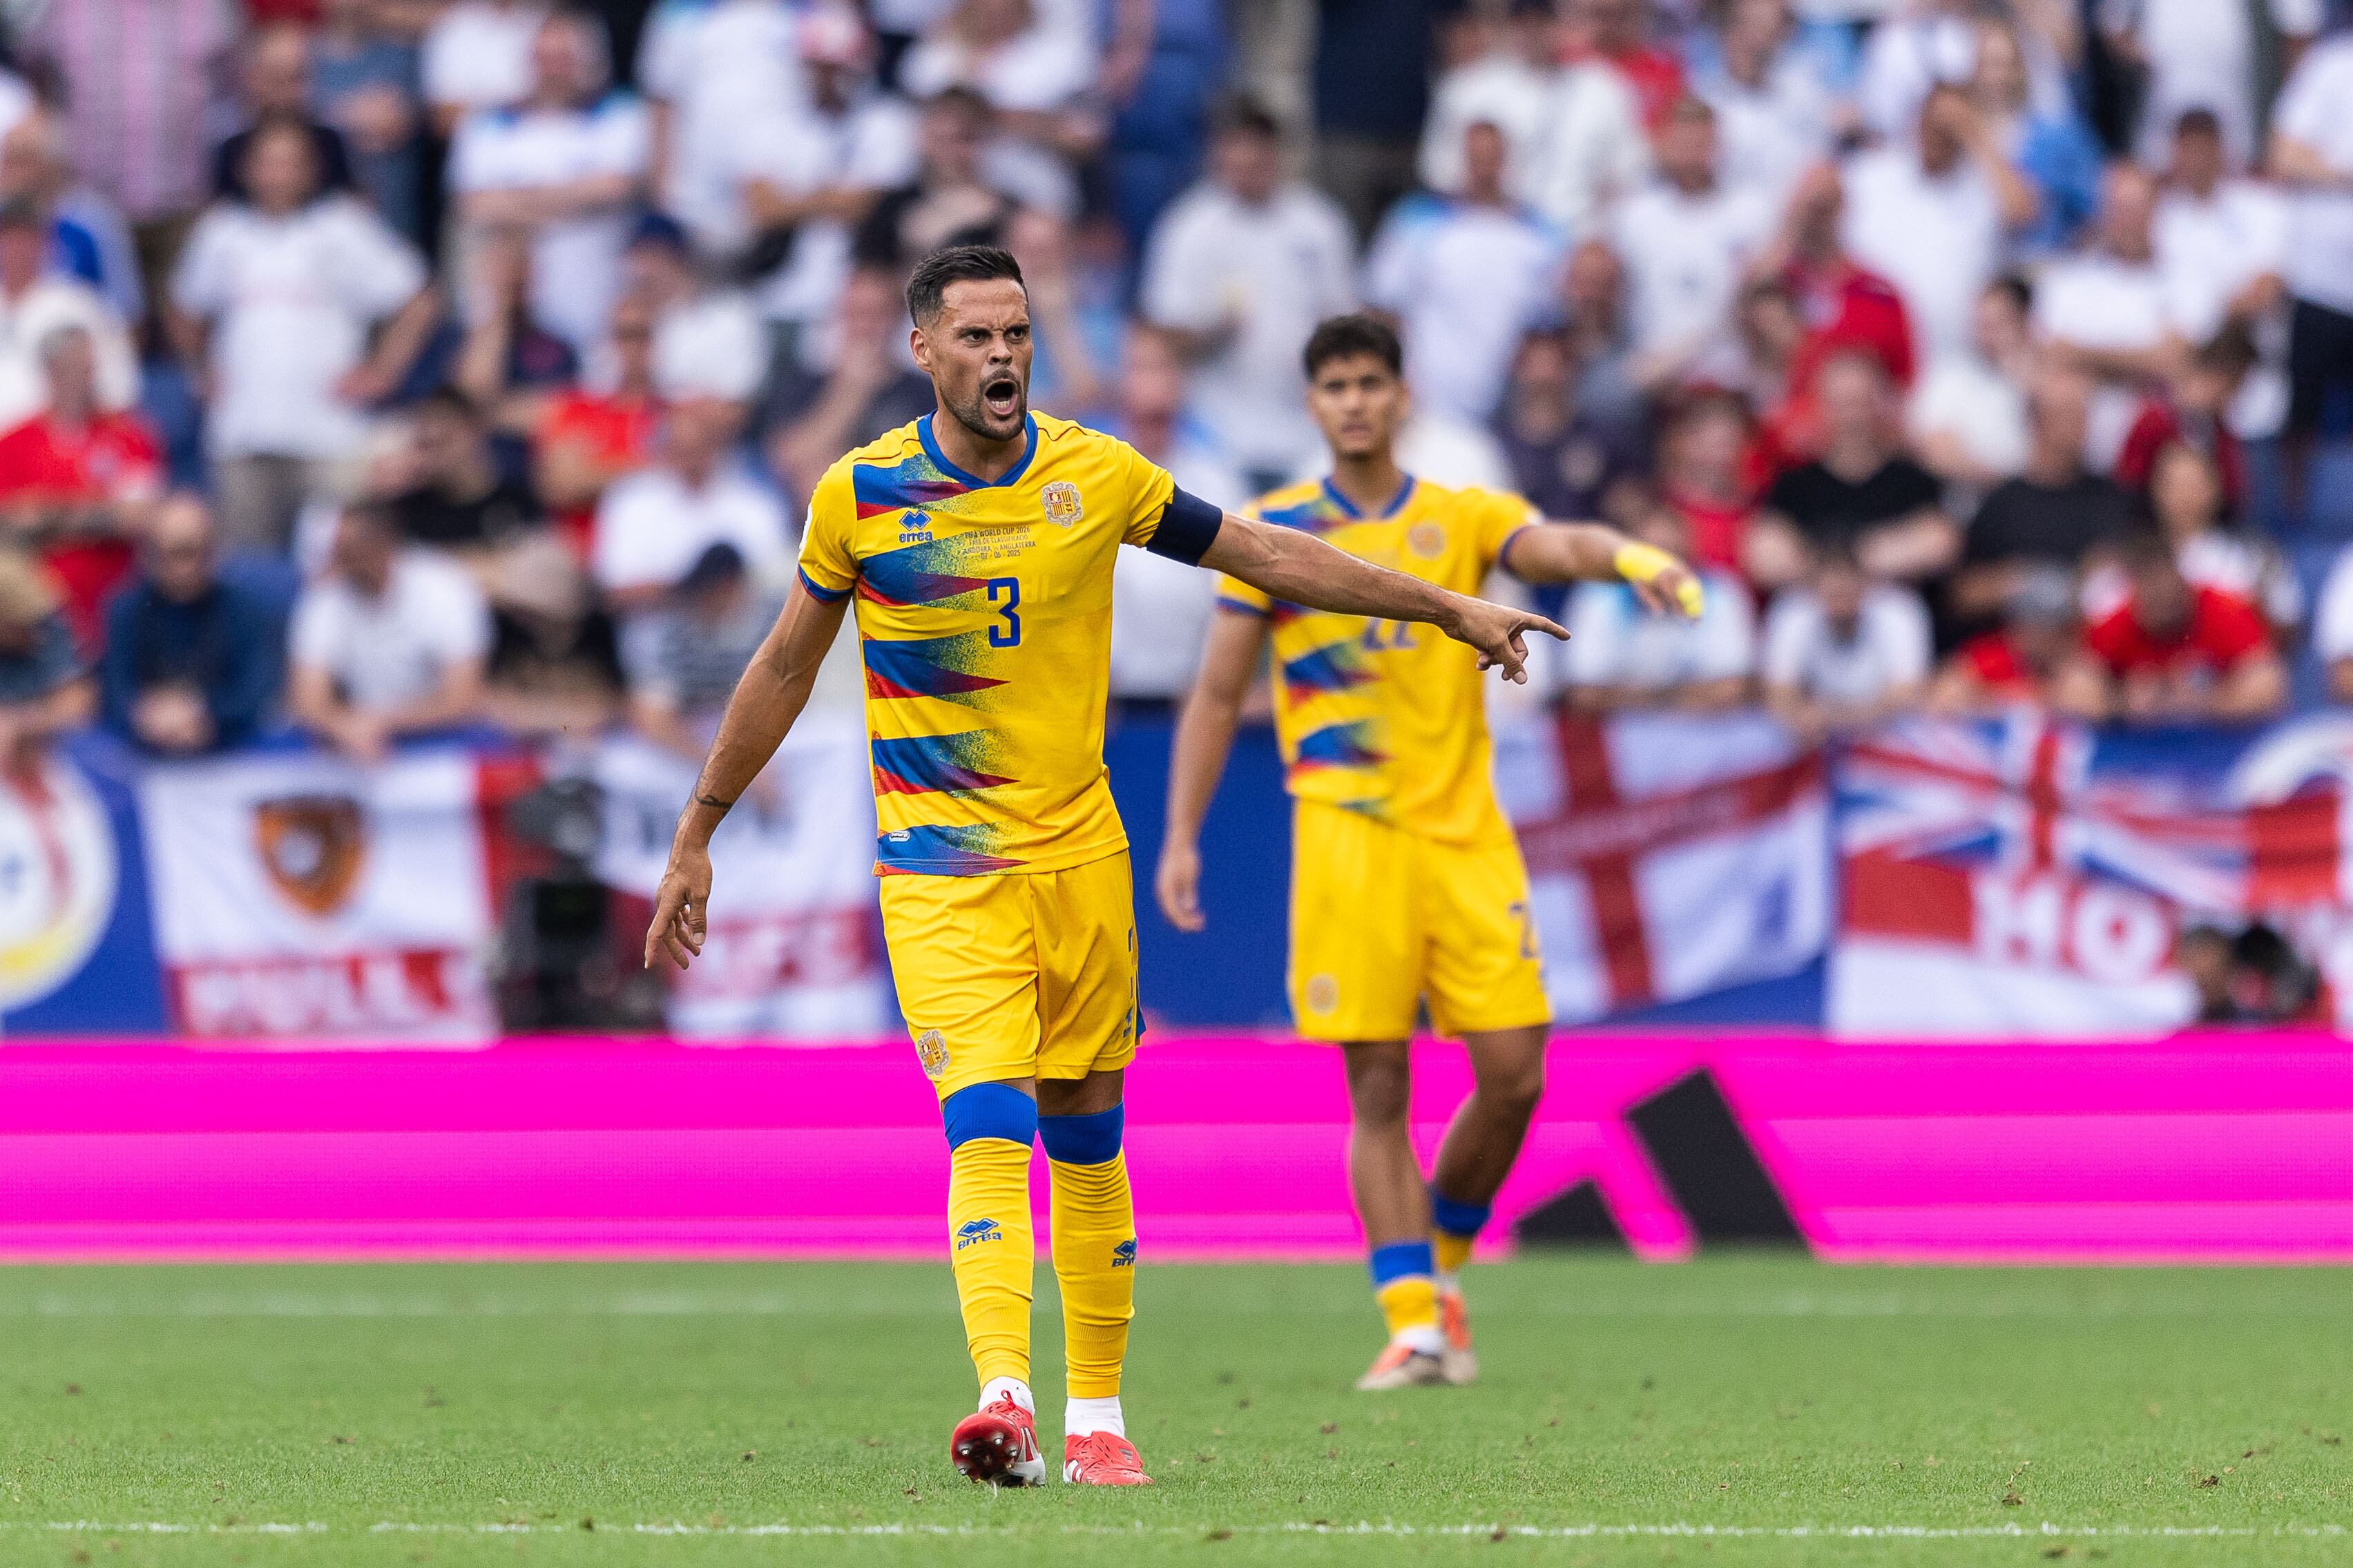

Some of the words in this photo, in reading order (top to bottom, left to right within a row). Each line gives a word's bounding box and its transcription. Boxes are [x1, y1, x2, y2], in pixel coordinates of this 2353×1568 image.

[979, 528, 1001, 537] WORLD
[1003, 527, 1015, 535] CUP
[1017, 525, 1030, 534] 2026
[1000, 541, 1037, 551] ANGLATERRA
[1007, 550, 1021, 558] 2025
[988, 577, 1021, 648] 3
